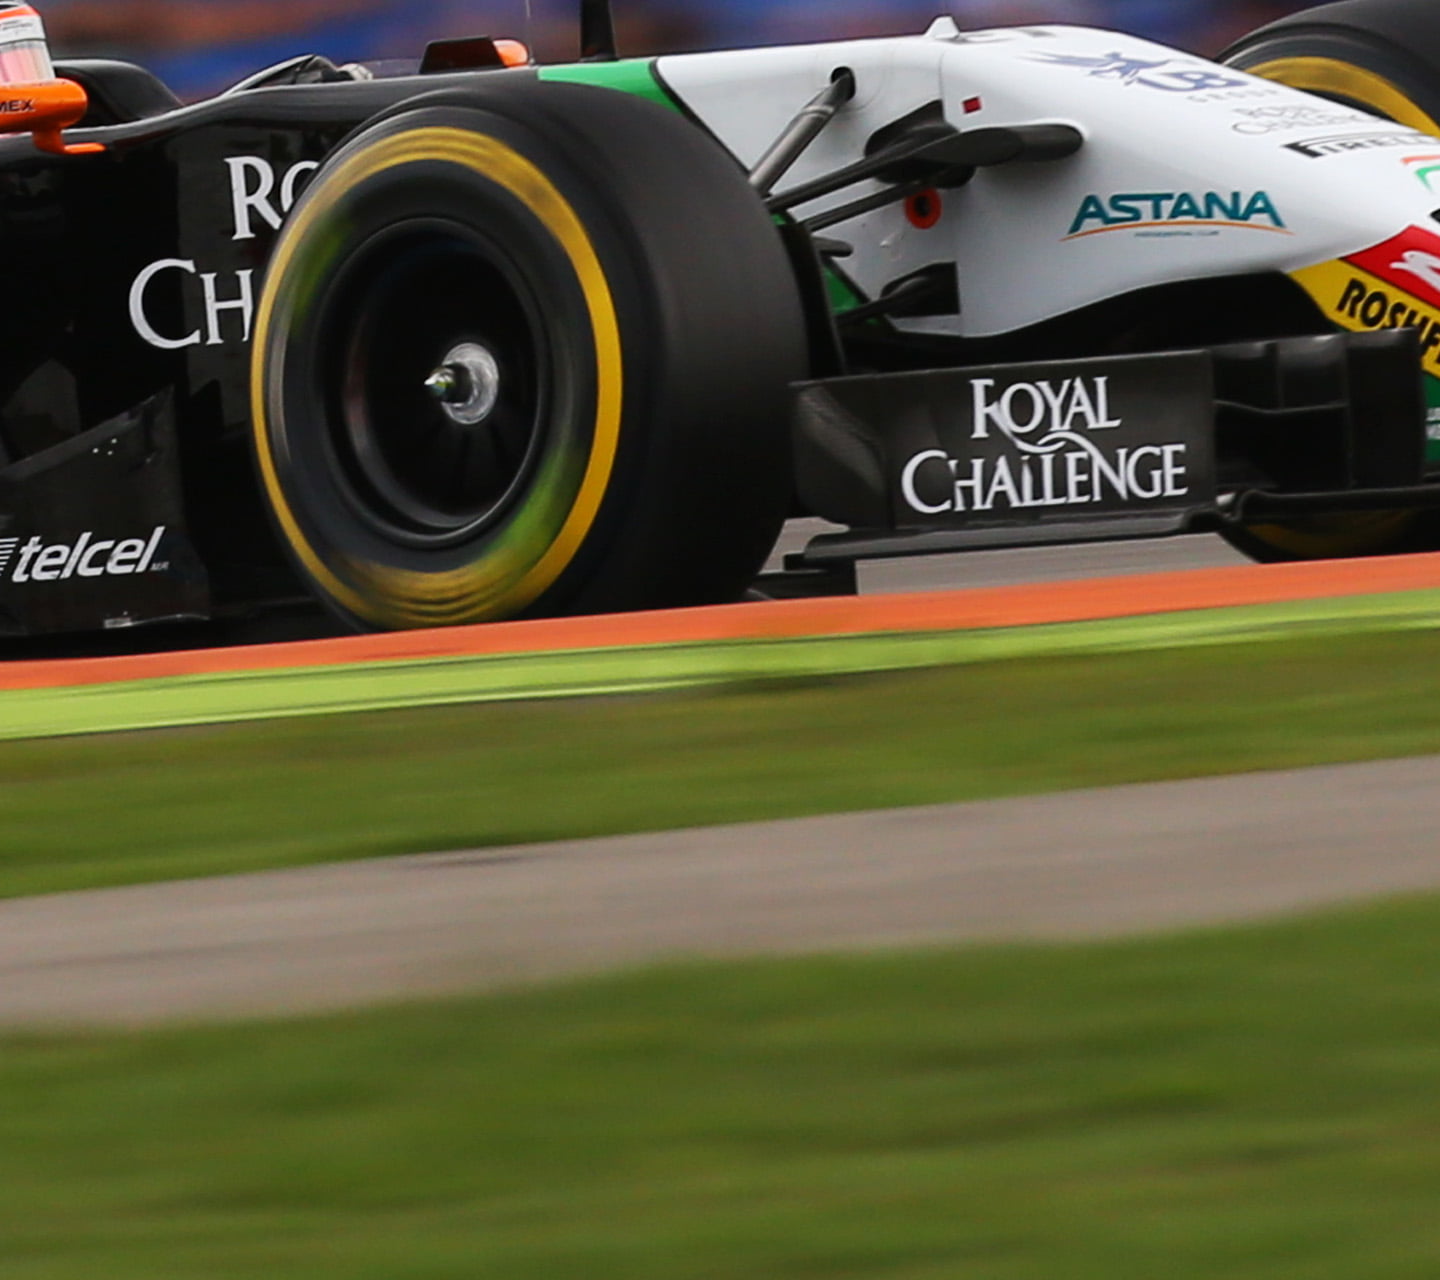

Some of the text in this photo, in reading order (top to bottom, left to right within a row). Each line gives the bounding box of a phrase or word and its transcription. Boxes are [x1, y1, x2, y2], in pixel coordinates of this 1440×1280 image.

[1068, 190, 1287, 235] ASTANA
[970, 376, 1122, 442] ROYAL
[901, 443, 1188, 516] CHALLENGE
[10, 525, 166, 584] telcel
